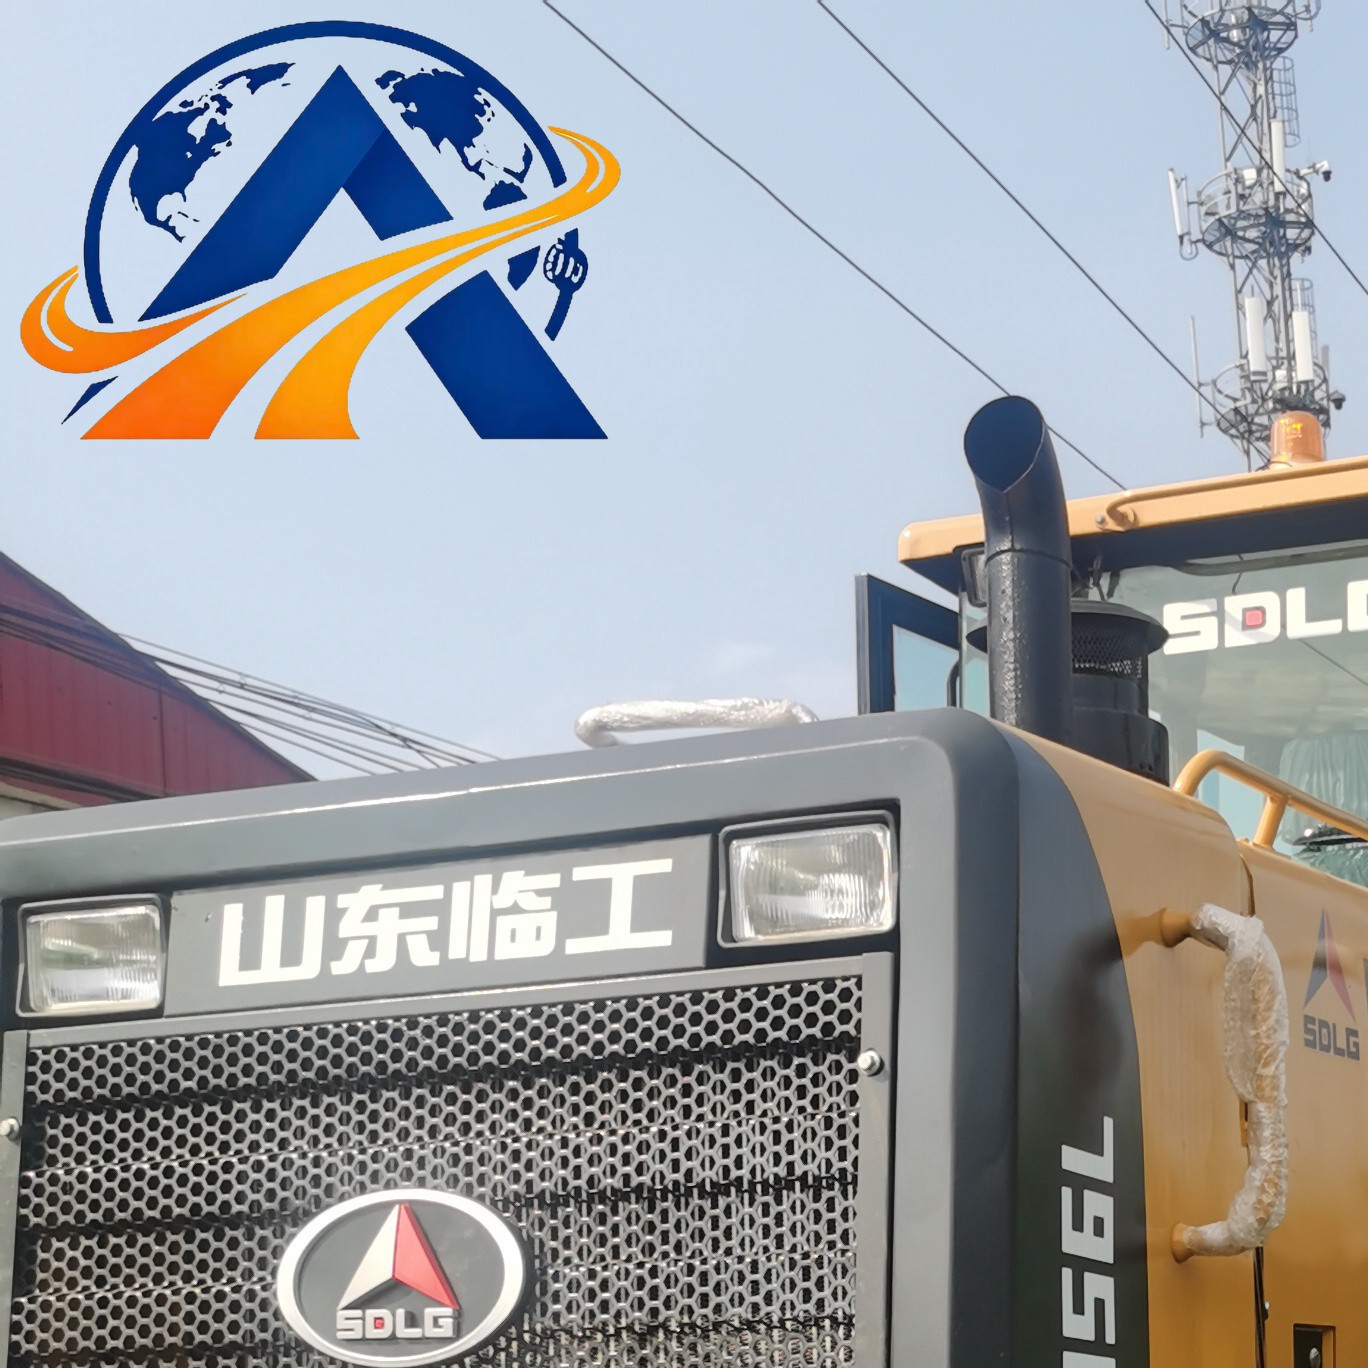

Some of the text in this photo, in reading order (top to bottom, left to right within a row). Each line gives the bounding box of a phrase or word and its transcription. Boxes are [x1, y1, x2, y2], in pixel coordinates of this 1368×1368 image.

[218, 858, 673, 987] 山东临工
[1303, 1014, 1361, 1062] SDLG
[336, 1307, 458, 1340] SDLG
